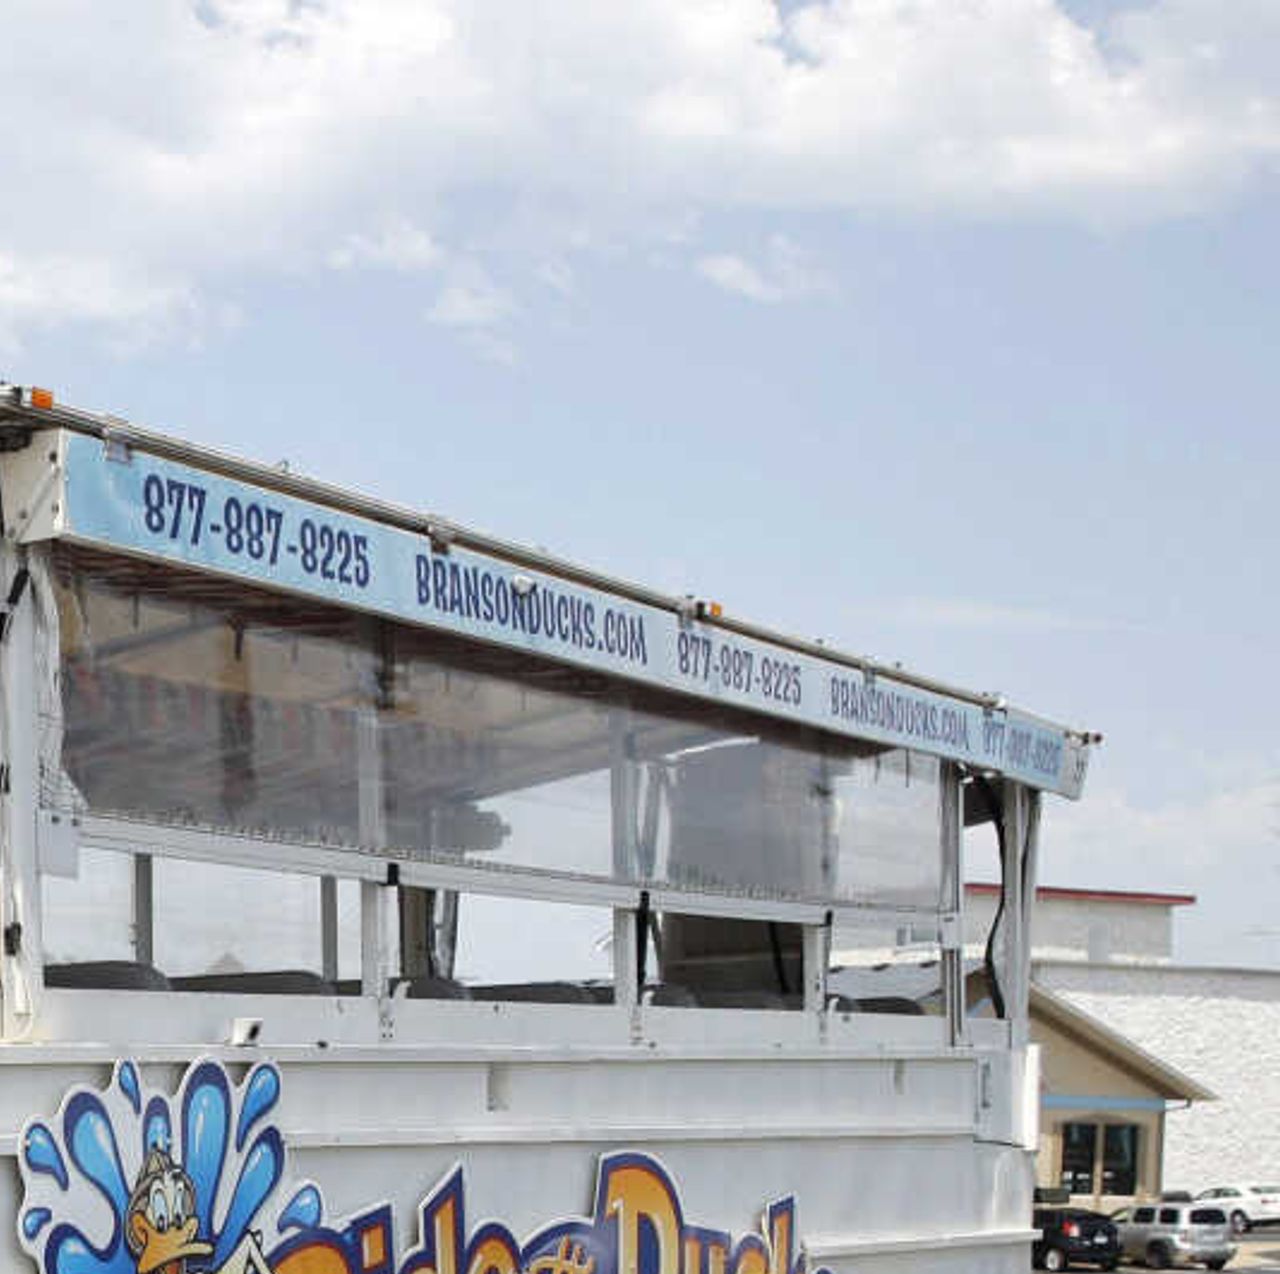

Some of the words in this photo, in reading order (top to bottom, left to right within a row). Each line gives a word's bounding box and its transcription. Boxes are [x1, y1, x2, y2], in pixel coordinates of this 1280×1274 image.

[143, 474, 371, 588] 877-887-8225
[415, 554, 648, 665] BRANSONDUCKS.COM
[678, 632, 802, 706] 877-887-8225
